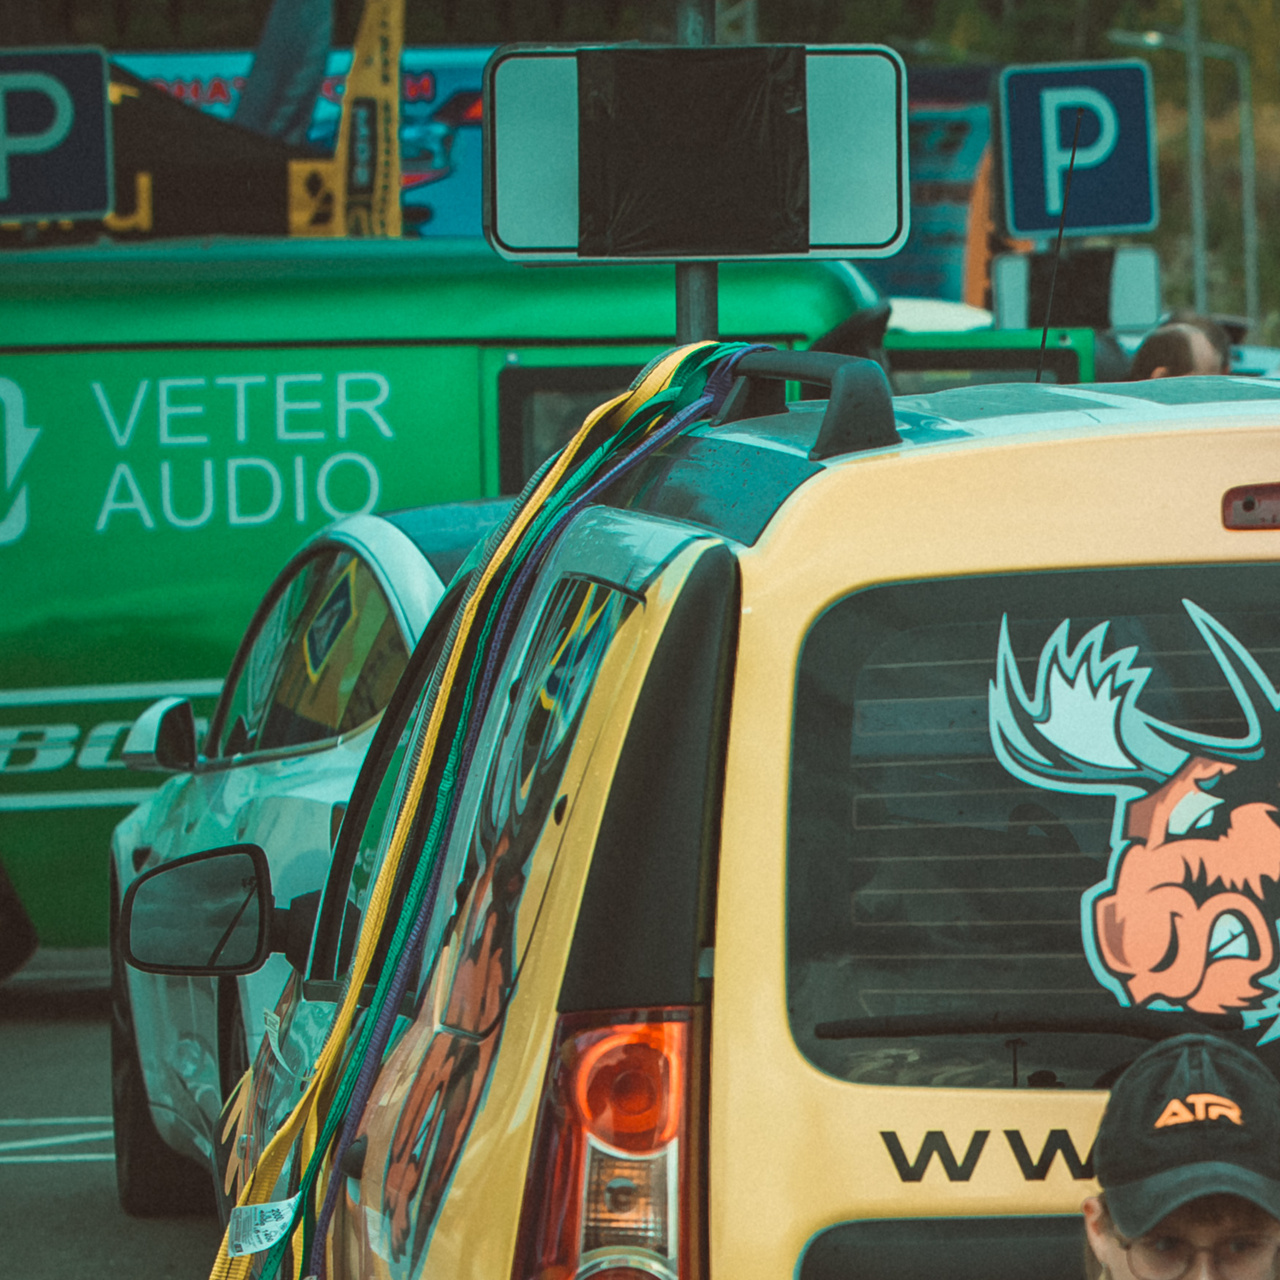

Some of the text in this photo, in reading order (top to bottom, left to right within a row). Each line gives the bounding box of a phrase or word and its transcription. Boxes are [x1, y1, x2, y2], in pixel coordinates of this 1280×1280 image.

[0, 72, 75, 200] P
[1039, 86, 1120, 216] P
[91, 372, 396, 446] VETER
[95, 451, 381, 532] AUDIO
[1154, 1093, 1245, 1129] ATR
